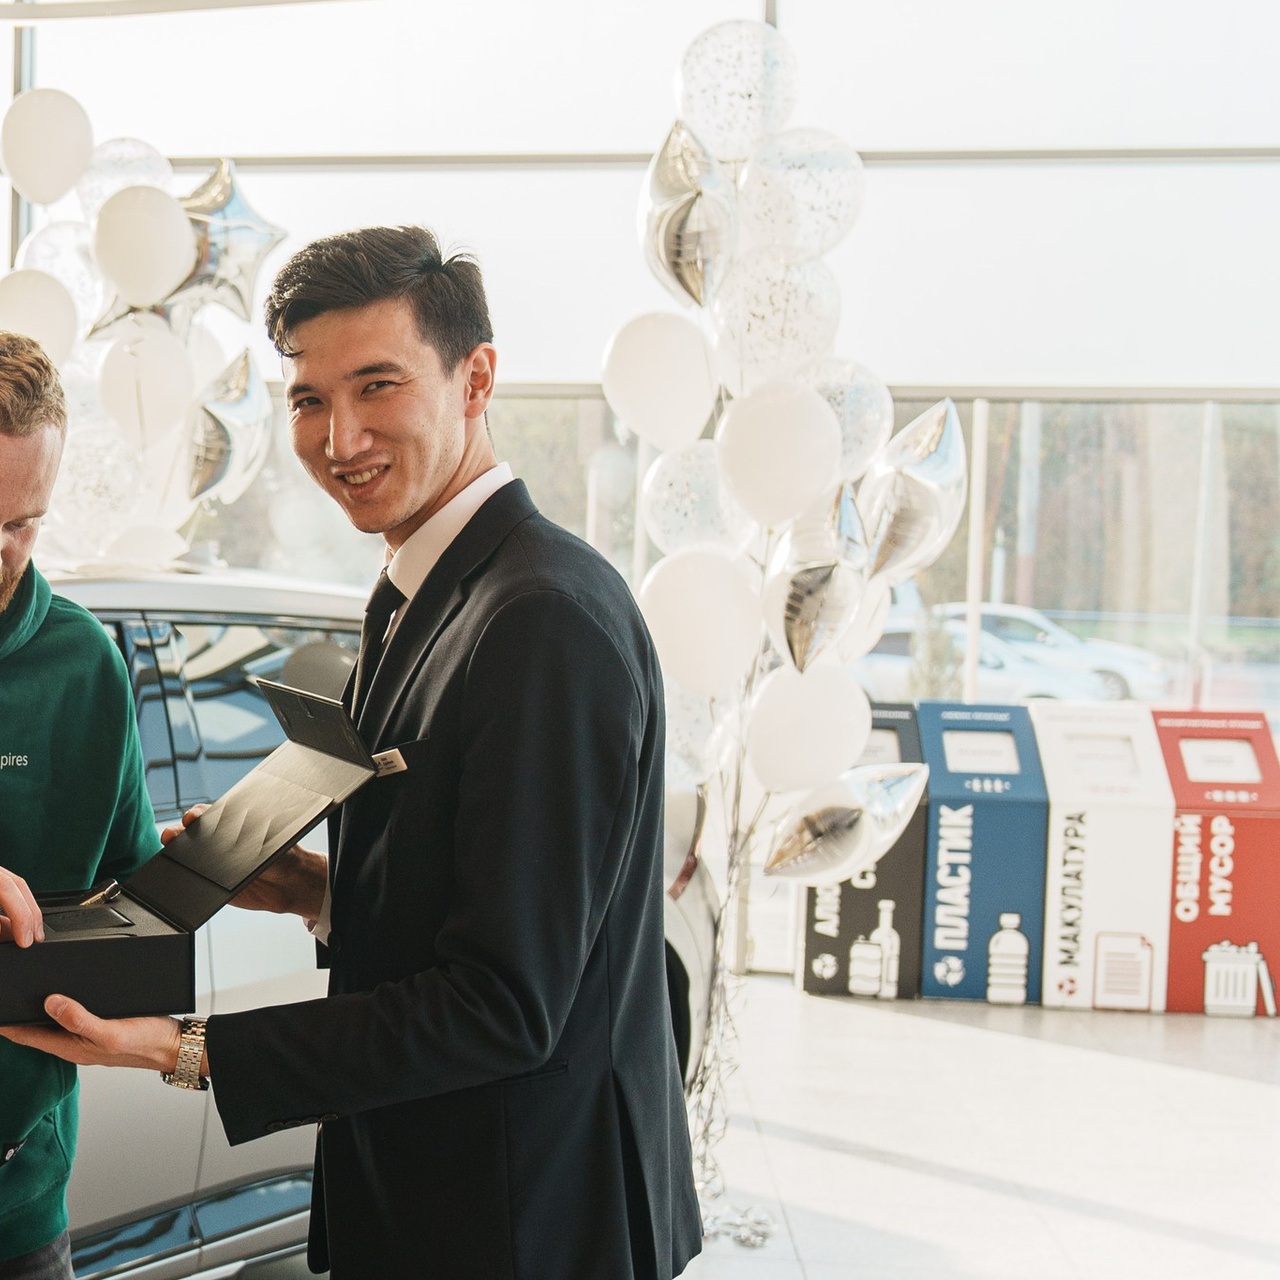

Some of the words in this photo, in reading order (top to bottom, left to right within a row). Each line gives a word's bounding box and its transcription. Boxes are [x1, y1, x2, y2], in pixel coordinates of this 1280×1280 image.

[934, 804, 974, 951] ПЛАСТИК
[1059, 812, 1086, 967] МАКУЛАТУРА
[1174, 814, 1203, 922] ОБЩИЙ
[1208, 815, 1235, 916] МУСОР
